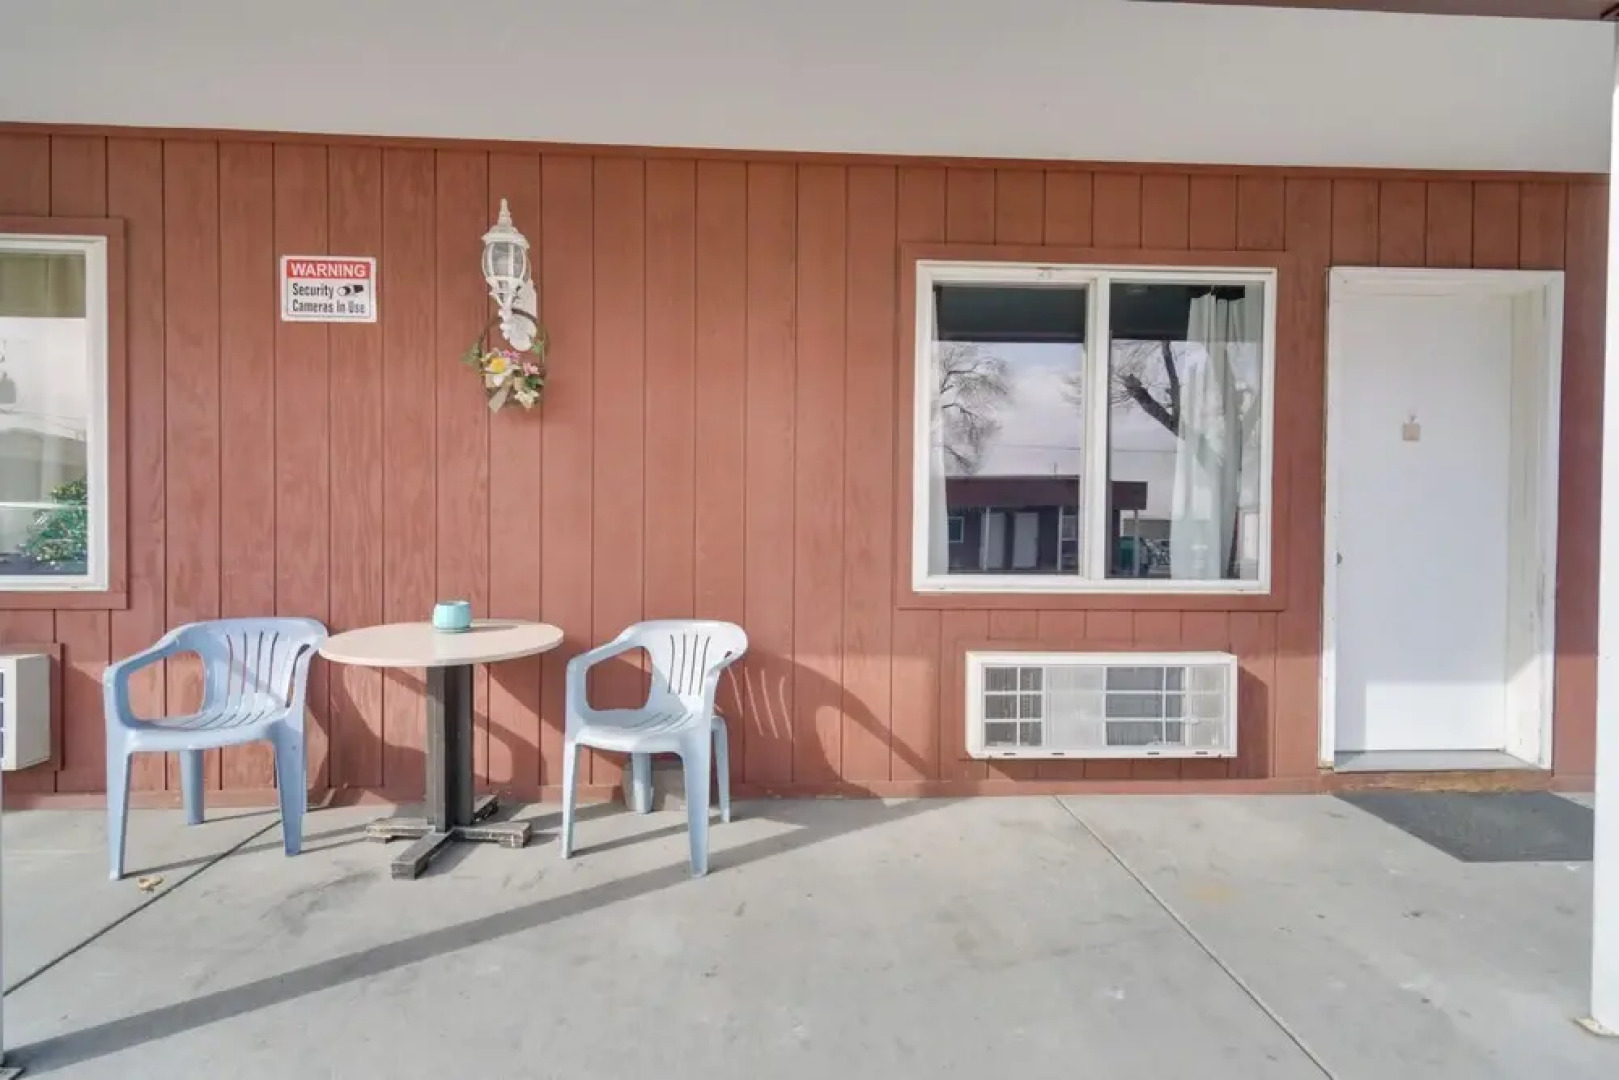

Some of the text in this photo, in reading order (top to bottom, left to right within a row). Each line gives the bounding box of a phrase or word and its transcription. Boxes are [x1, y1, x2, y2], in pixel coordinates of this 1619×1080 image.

[291, 263, 365, 277] WARNING
[293, 283, 333, 299] Security
[293, 300, 365, 313] Cameras In Use
